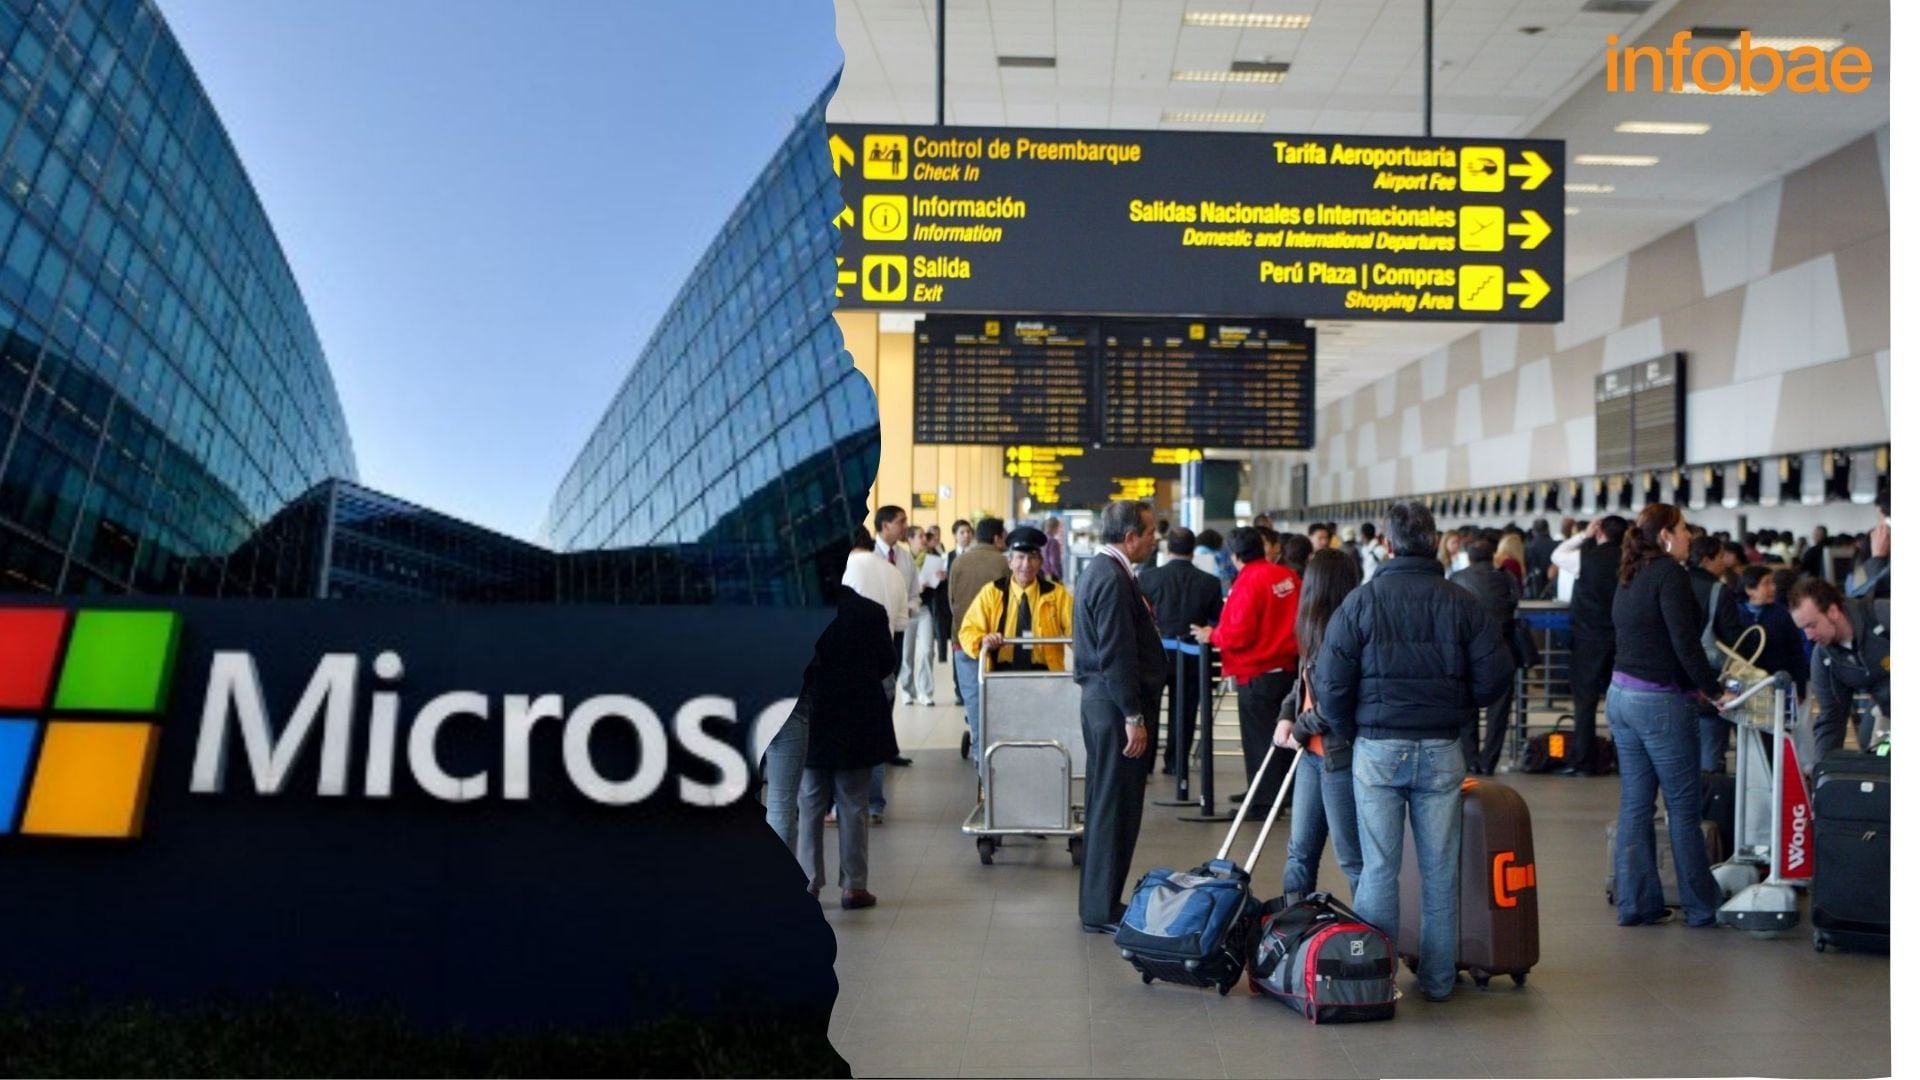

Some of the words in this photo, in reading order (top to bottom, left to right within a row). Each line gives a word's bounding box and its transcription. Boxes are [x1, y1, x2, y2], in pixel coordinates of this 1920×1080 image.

[914, 136, 983, 157] Control
[988, 141, 1011, 158] de
[1016, 139, 1141, 163] Preembarque
[1275, 141, 1327, 164] Tarifa
[1330, 144, 1457, 169] Aeroportuaria
[914, 162, 959, 180] Check
[963, 163, 980, 181] In
[1374, 171, 1425, 192] Airport
[1427, 172, 1457, 191] Fee
[912, 196, 1026, 218] Información
[1130, 199, 1196, 223] Salidas
[1199, 201, 1302, 225] Nacionales
[1303, 207, 1314, 225] e
[1316, 204, 1457, 228] Internacionales
[913, 224, 1002, 242] Information
[1183, 227, 1254, 246] Domestic
[1254, 231, 1283, 247] and
[1283, 231, 1375, 249] International
[1375, 232, 1456, 252] Departures
[913, 256, 971, 278] Salida
[1260, 261, 1304, 283] Perú
[1308, 262, 1358, 285] Plaza
[1372, 262, 1457, 288] Compras
[914, 283, 943, 302] Exit
[1346, 288, 1416, 312] Shopping
[1417, 292, 1455, 310] Area
